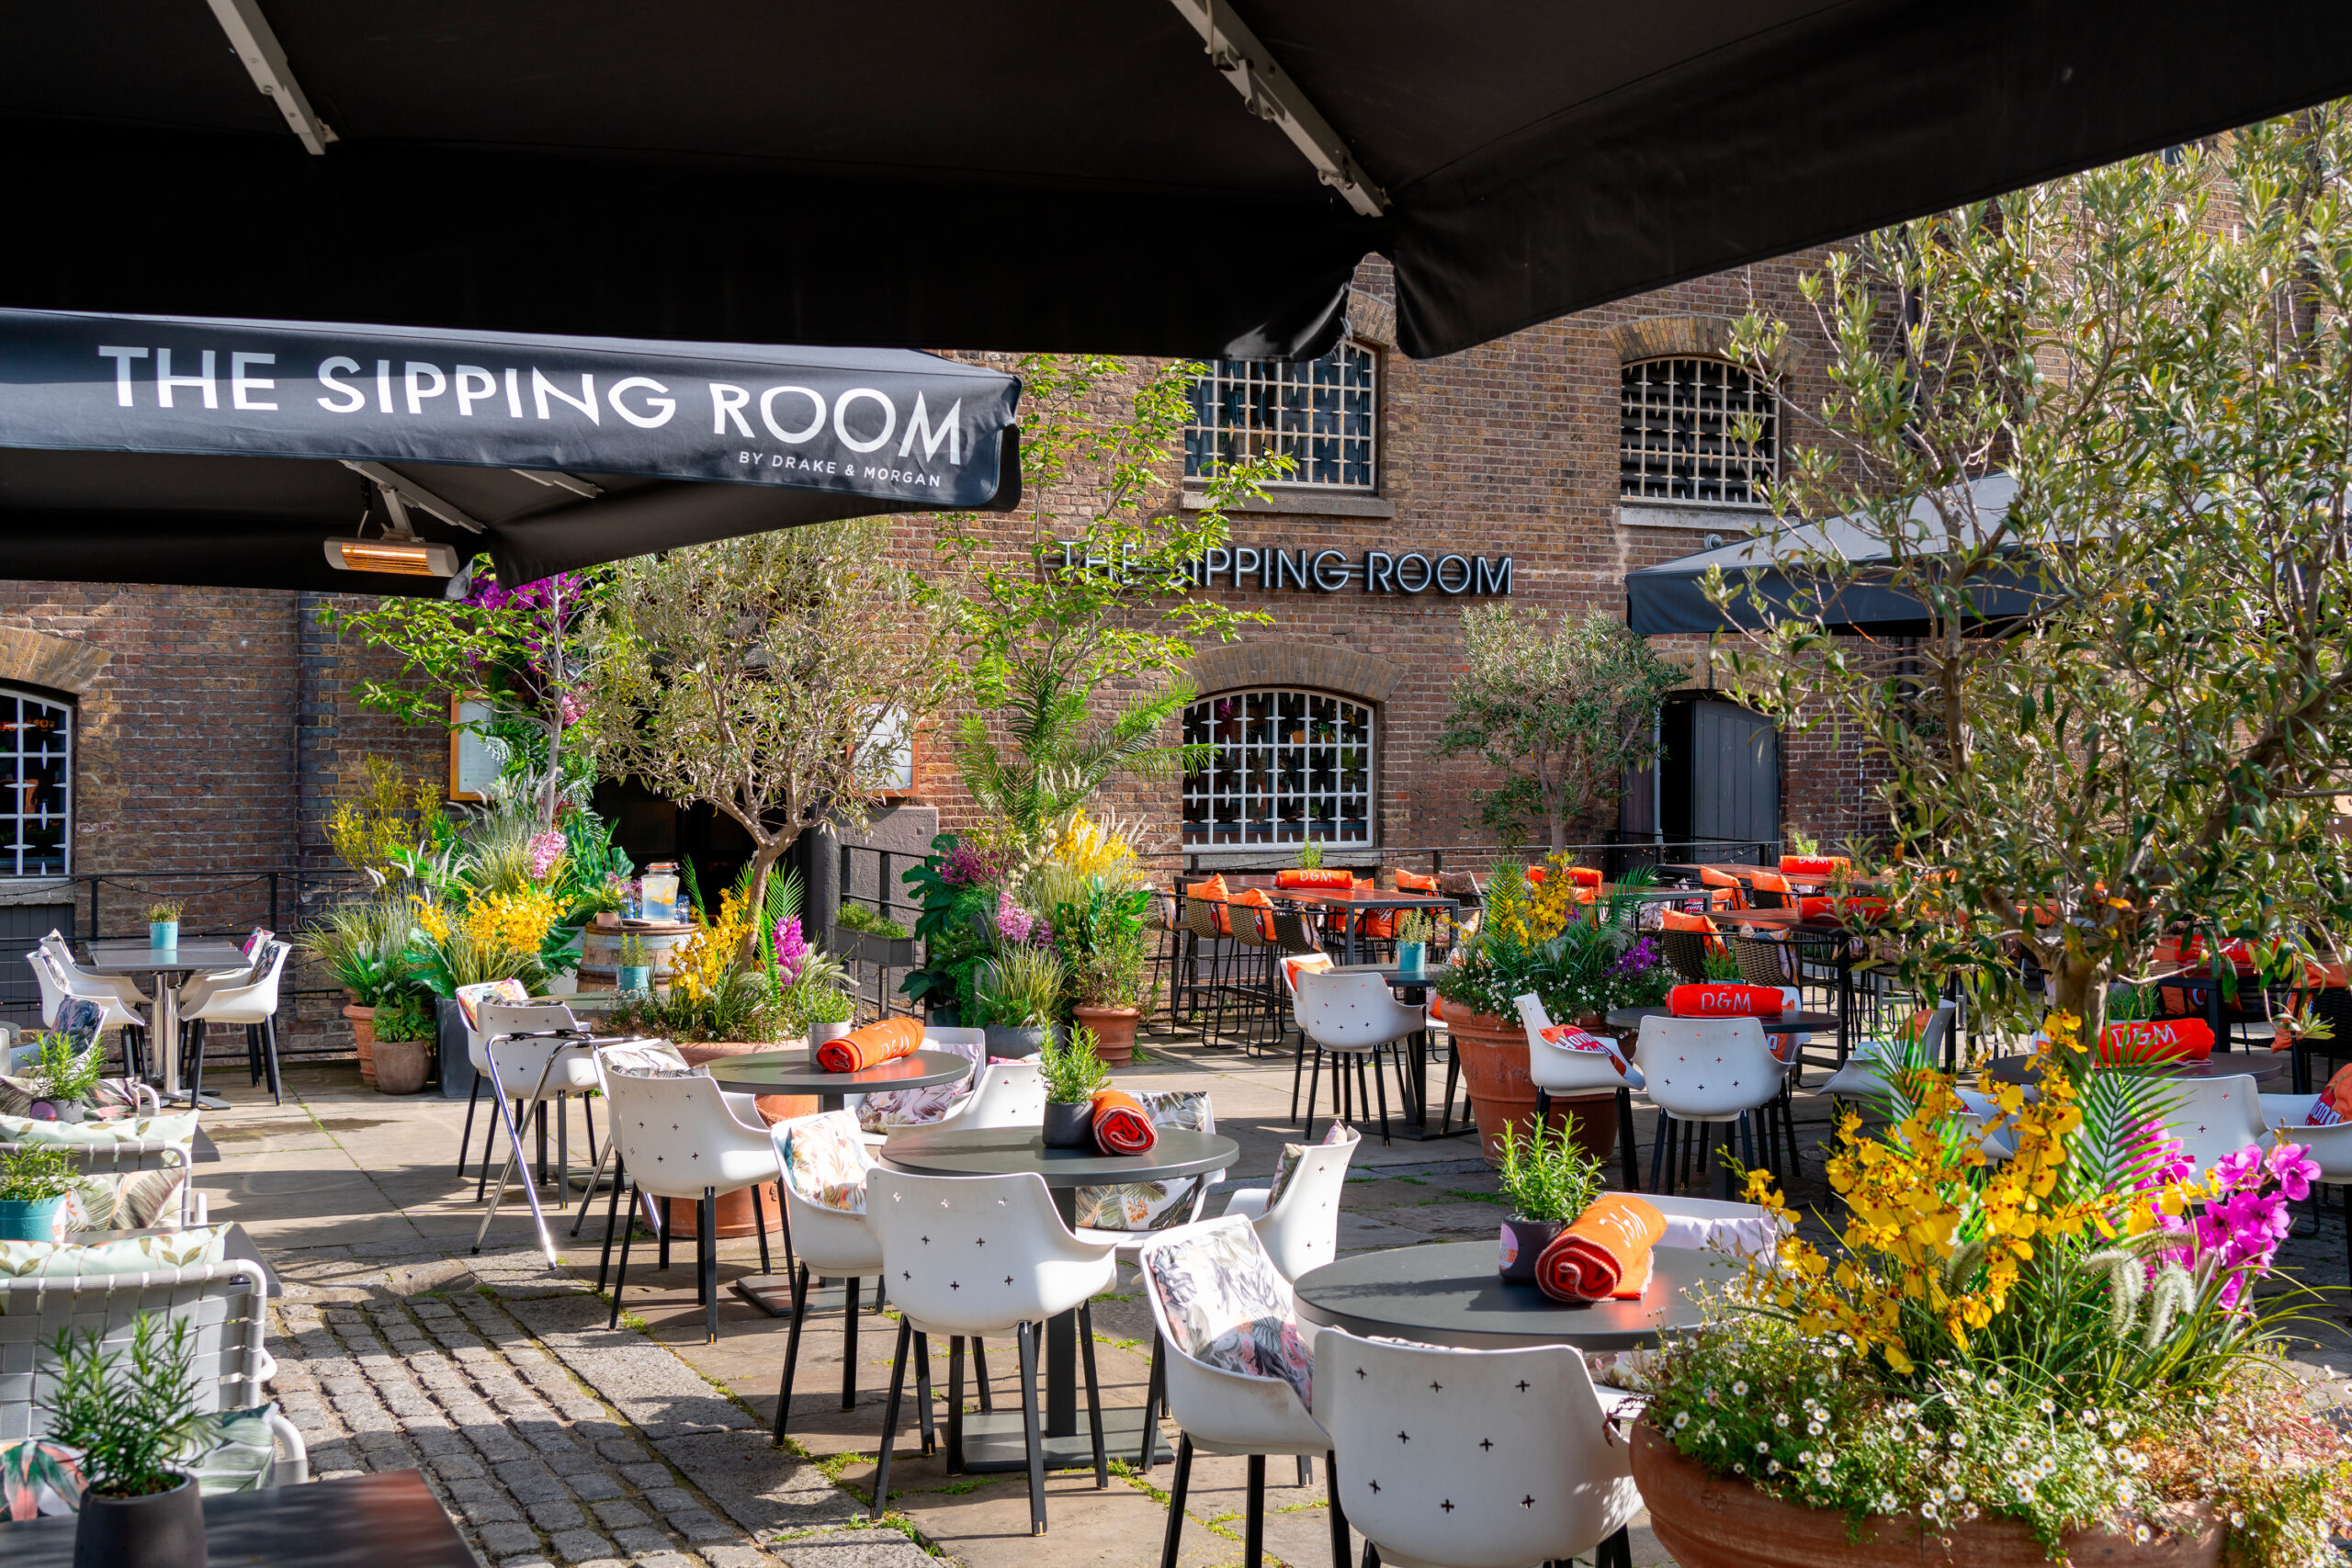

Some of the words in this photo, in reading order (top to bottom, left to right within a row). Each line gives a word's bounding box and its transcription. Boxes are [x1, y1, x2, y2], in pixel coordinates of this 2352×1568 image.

[98, 345, 278, 411] THE
[317, 356, 676, 428] SIPPING
[709, 383, 961, 465] ROOM
[740, 451, 763, 464] BY
[772, 455, 836, 474] DRAKE
[844, 465, 855, 477] &
[865, 467, 940, 488] MORGAN
[1365, 551, 1512, 594] ROOM
[1701, 992, 1751, 1012] D&M
